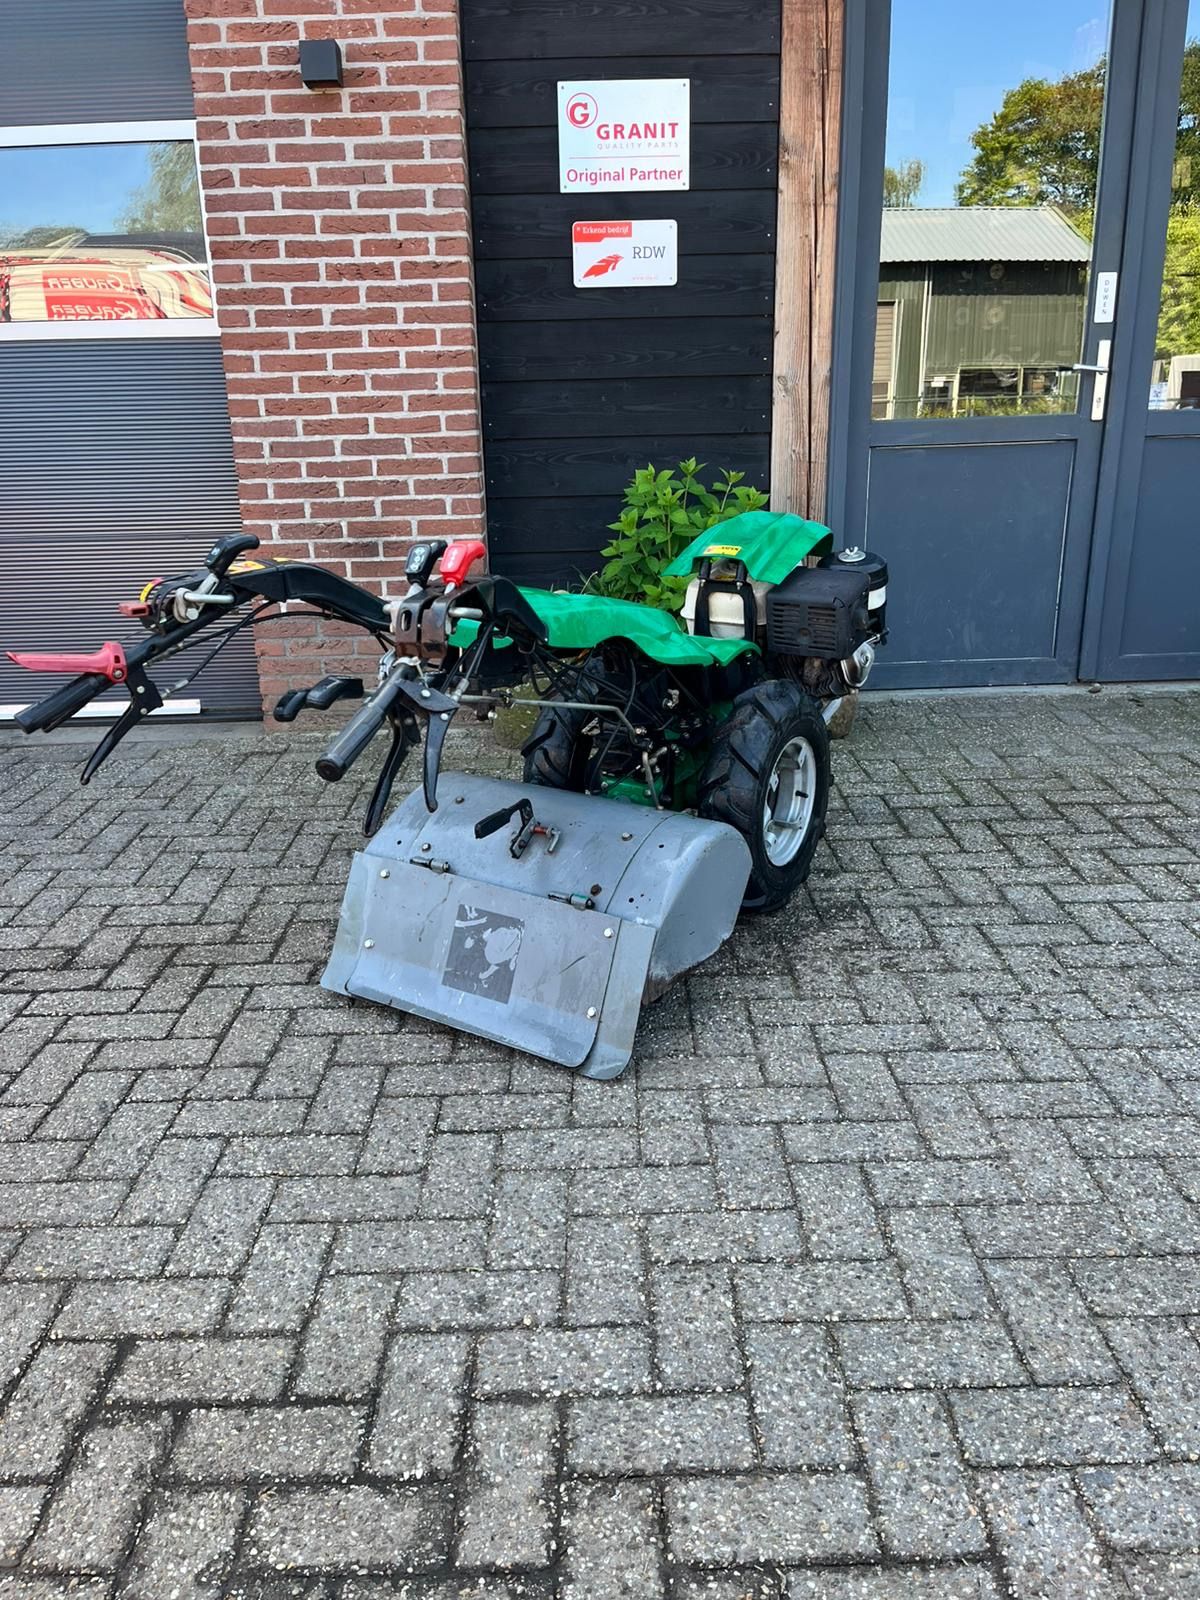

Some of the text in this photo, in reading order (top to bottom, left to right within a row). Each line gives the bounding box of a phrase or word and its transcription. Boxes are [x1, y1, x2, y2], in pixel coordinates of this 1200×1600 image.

[569, 102, 590, 125] G
[596, 122, 680, 140] GRANIT
[597, 143, 643, 151] QUALITY
[566, 166, 684, 186] Original Partner
[582, 225, 630, 236] Erkend bedrijf
[632, 246, 666, 260] RDW
[1101, 279, 1110, 315] DUWEN
